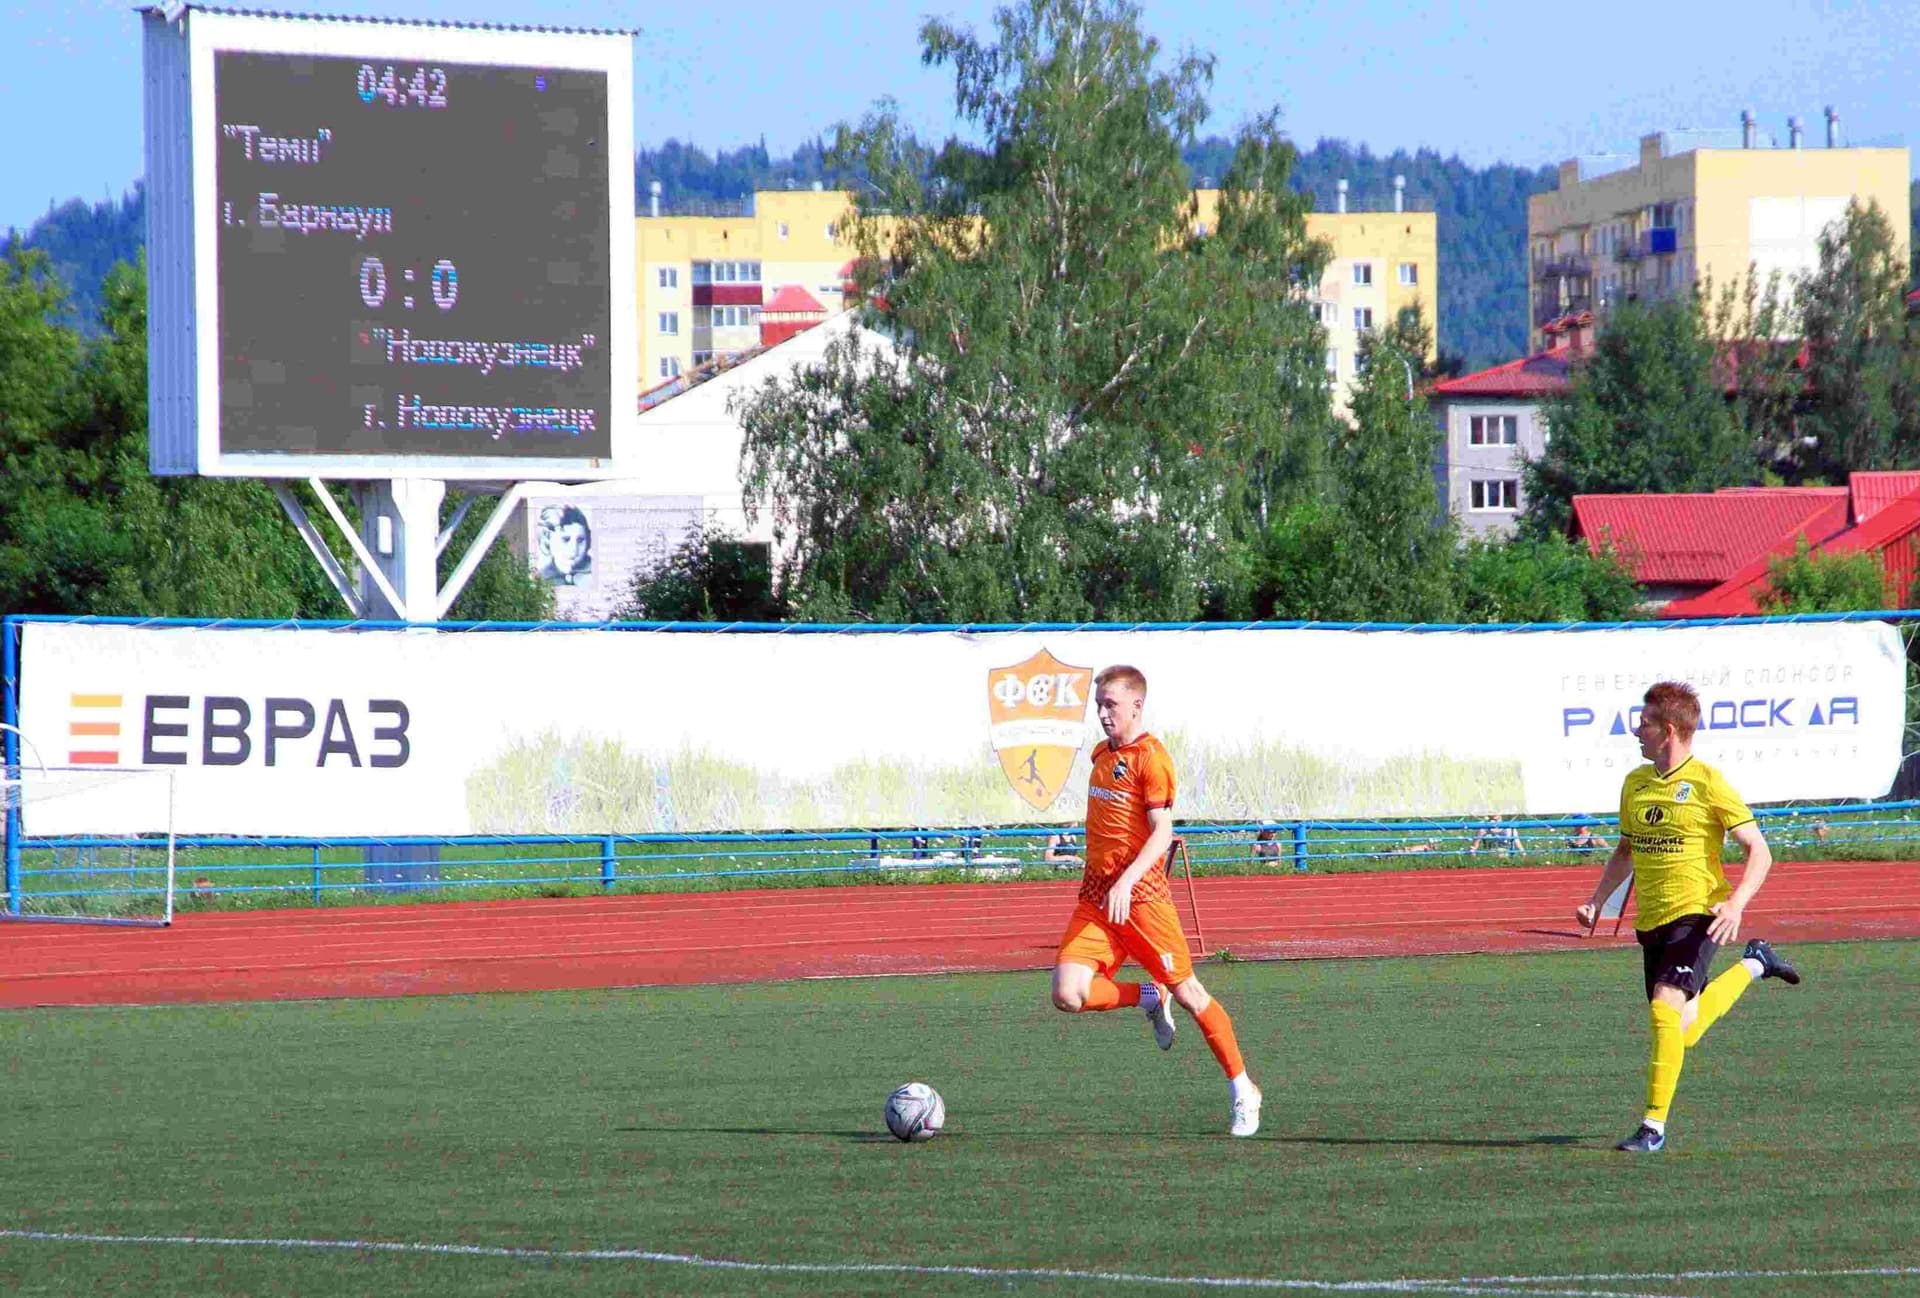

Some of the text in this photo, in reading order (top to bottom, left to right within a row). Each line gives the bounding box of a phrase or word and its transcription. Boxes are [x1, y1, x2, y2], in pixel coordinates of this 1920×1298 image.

[357, 64, 447, 107] 04:42
[259, 192, 393, 241] Барнаул
[398, 394, 597, 441] Новокузнецк
[142, 694, 411, 768] ЕВРАЗ
